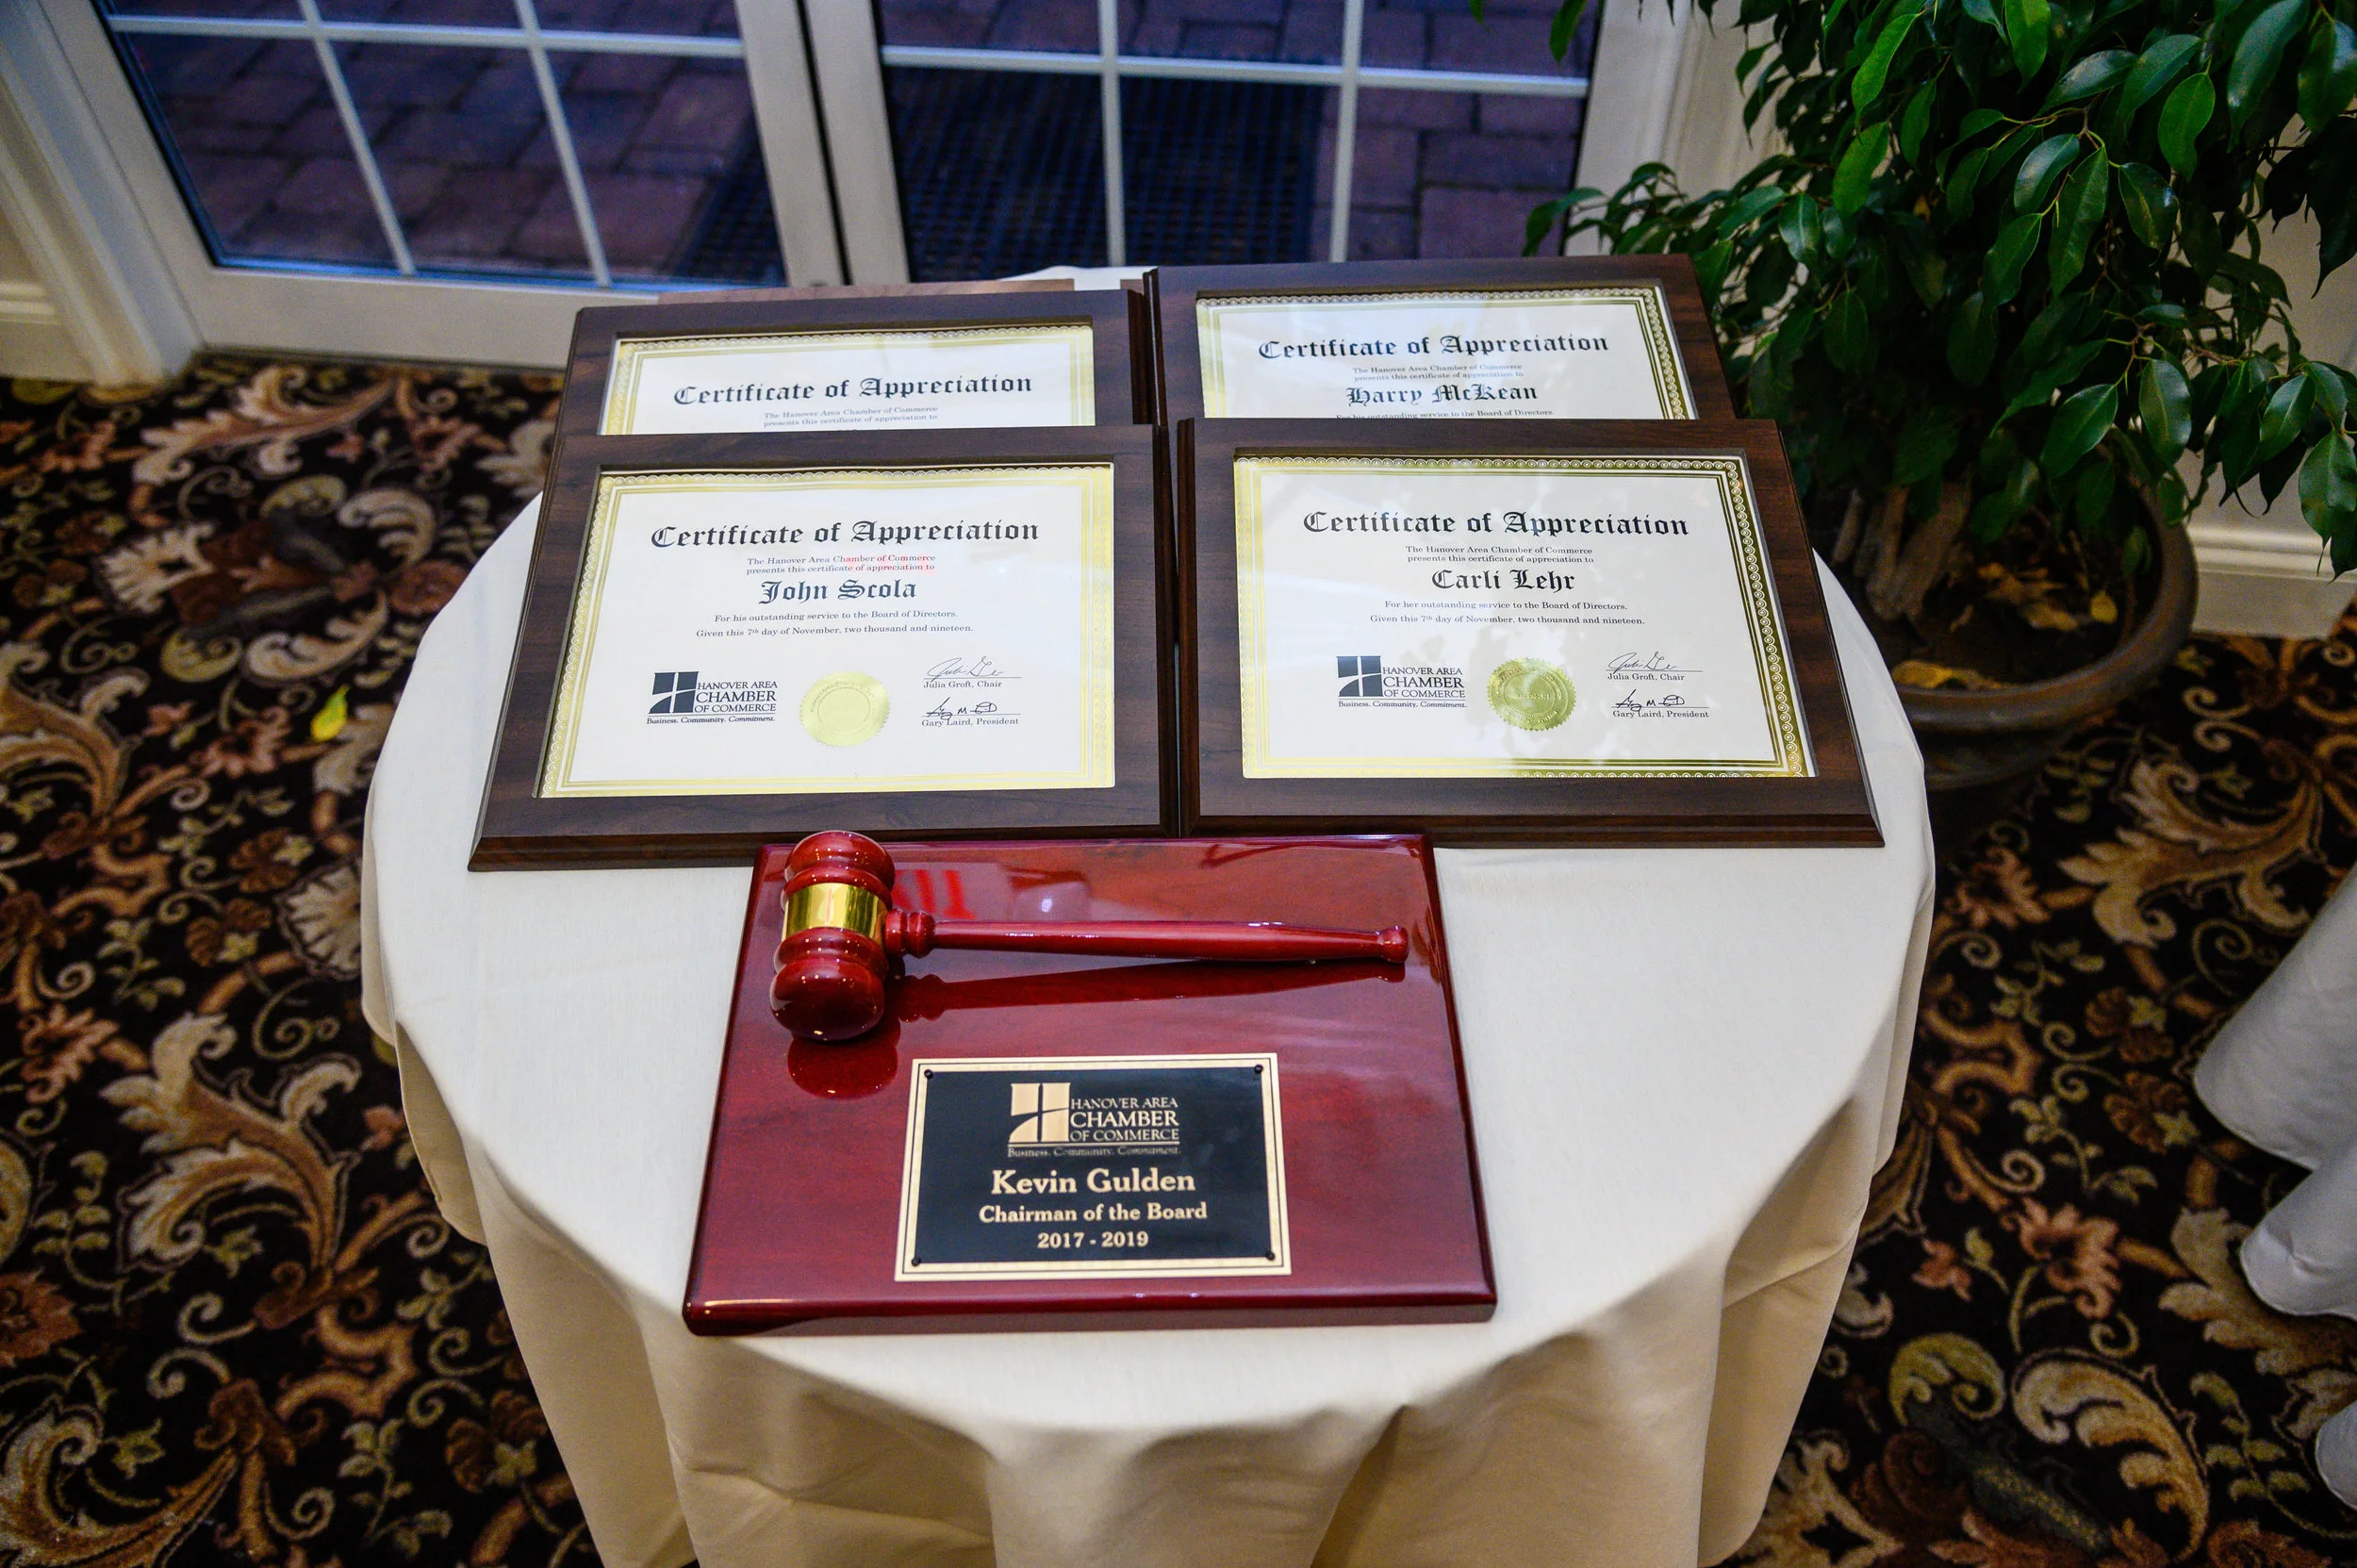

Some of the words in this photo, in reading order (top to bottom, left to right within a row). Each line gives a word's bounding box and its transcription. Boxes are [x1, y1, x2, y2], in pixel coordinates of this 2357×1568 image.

[1258, 338, 1396, 358] Certificate
[1407, 336, 1430, 354] of
[1440, 335, 1608, 355] Appreciation
[673, 384, 815, 404] Certificate
[825, 379, 849, 397] of
[859, 375, 1031, 398] Appreciation
[1345, 387, 1422, 406] Harry
[1432, 384, 1537, 402] McKean
[763, 420, 799, 428] presents
[874, 415, 926, 423] appreciation
[1303, 511, 1456, 532] Certificate
[1466, 512, 1492, 533] of
[1503, 511, 1689, 536] Appreciation
[651, 525, 803, 547] Certificate
[814, 521, 841, 542] of
[850, 520, 1038, 544] Appreciation
[832, 554, 875, 563] Chamber
[1407, 555, 1446, 564] presents
[1526, 556, 1582, 565] appreciation
[746, 567, 784, 576] presents
[807, 565, 852, 573] certificate
[865, 564, 923, 573] appreciation
[1431, 569, 1501, 588] Carli
[1508, 569, 1574, 592] Lehr
[758, 580, 828, 603] John
[837, 579, 916, 599] Scola
[1384, 601, 1401, 609] For
[1402, 601, 1419, 609] her
[1421, 602, 1476, 611] outstanding
[1541, 602, 1569, 610] Board
[1571, 602, 1581, 610] of
[1582, 602, 1627, 610] Directors.
[733, 614, 747, 622] his
[749, 613, 805, 622] outstanding
[870, 611, 898, 619] Board
[900, 610, 912, 619] of
[913, 610, 957, 619] Directors.
[1370, 615, 1397, 623] Given
[1400, 615, 1418, 623] this
[1435, 616, 1451, 625] day
[1465, 616, 1515, 624] November,
[1539, 616, 1579, 624] thousand
[696, 629, 723, 637] Given
[761, 628, 778, 637] day
[780, 627, 790, 635] of
[791, 627, 841, 635] November,
[864, 625, 907, 634] thousand
[1382, 667, 1434, 675] HANOVER
[698, 682, 749, 690] HANOVER
[1383, 677, 1465, 688] CHAMBER
[696, 690, 777, 702] CHAMBER
[694, 704, 710, 713] OF
[712, 703, 776, 713] COMMERCE
[1071, 1097, 1140, 1110] HANOVER
[1142, 1097, 1178, 1108] AREA
[1069, 1110, 1179, 1128] CHAMBER
[1069, 1130, 1090, 1142] OF
[1092, 1128, 1179, 1141] COMMERCE
[991, 1169, 1077, 1194] Kevin
[1086, 1167, 1195, 1192] Gulden
[979, 1204, 1077, 1223] Chairman
[1082, 1203, 1104, 1221] of
[1108, 1202, 1141, 1220] the
[1146, 1201, 1207, 1220] Board
[1037, 1231, 1084, 1248] 2017
[1100, 1230, 1148, 1247] 2019
